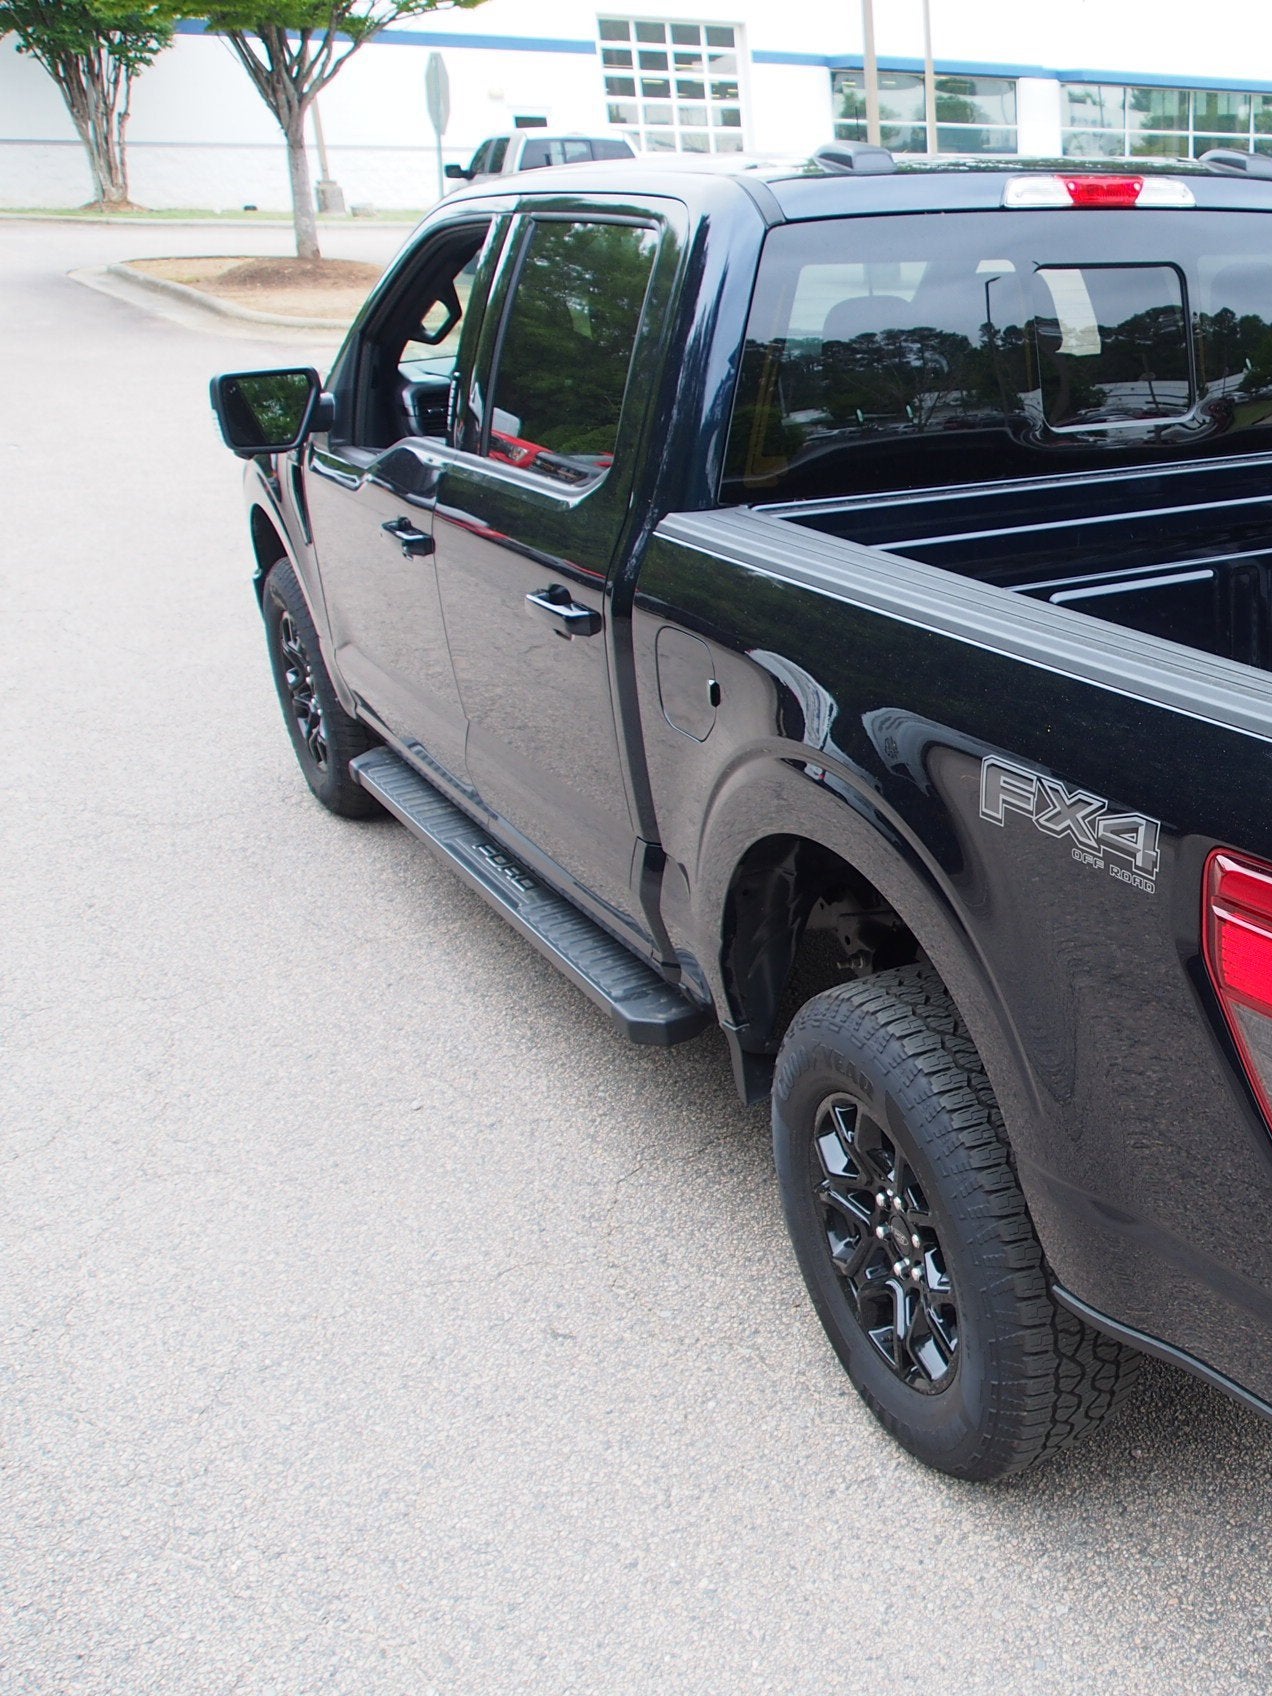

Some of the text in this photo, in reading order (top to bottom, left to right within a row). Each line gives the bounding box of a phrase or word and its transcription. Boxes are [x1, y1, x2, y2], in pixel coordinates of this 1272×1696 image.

[980, 754, 1161, 880] FX4
[471, 843, 539, 892] FORD
[1071, 848, 1156, 894] OFF ROAD
